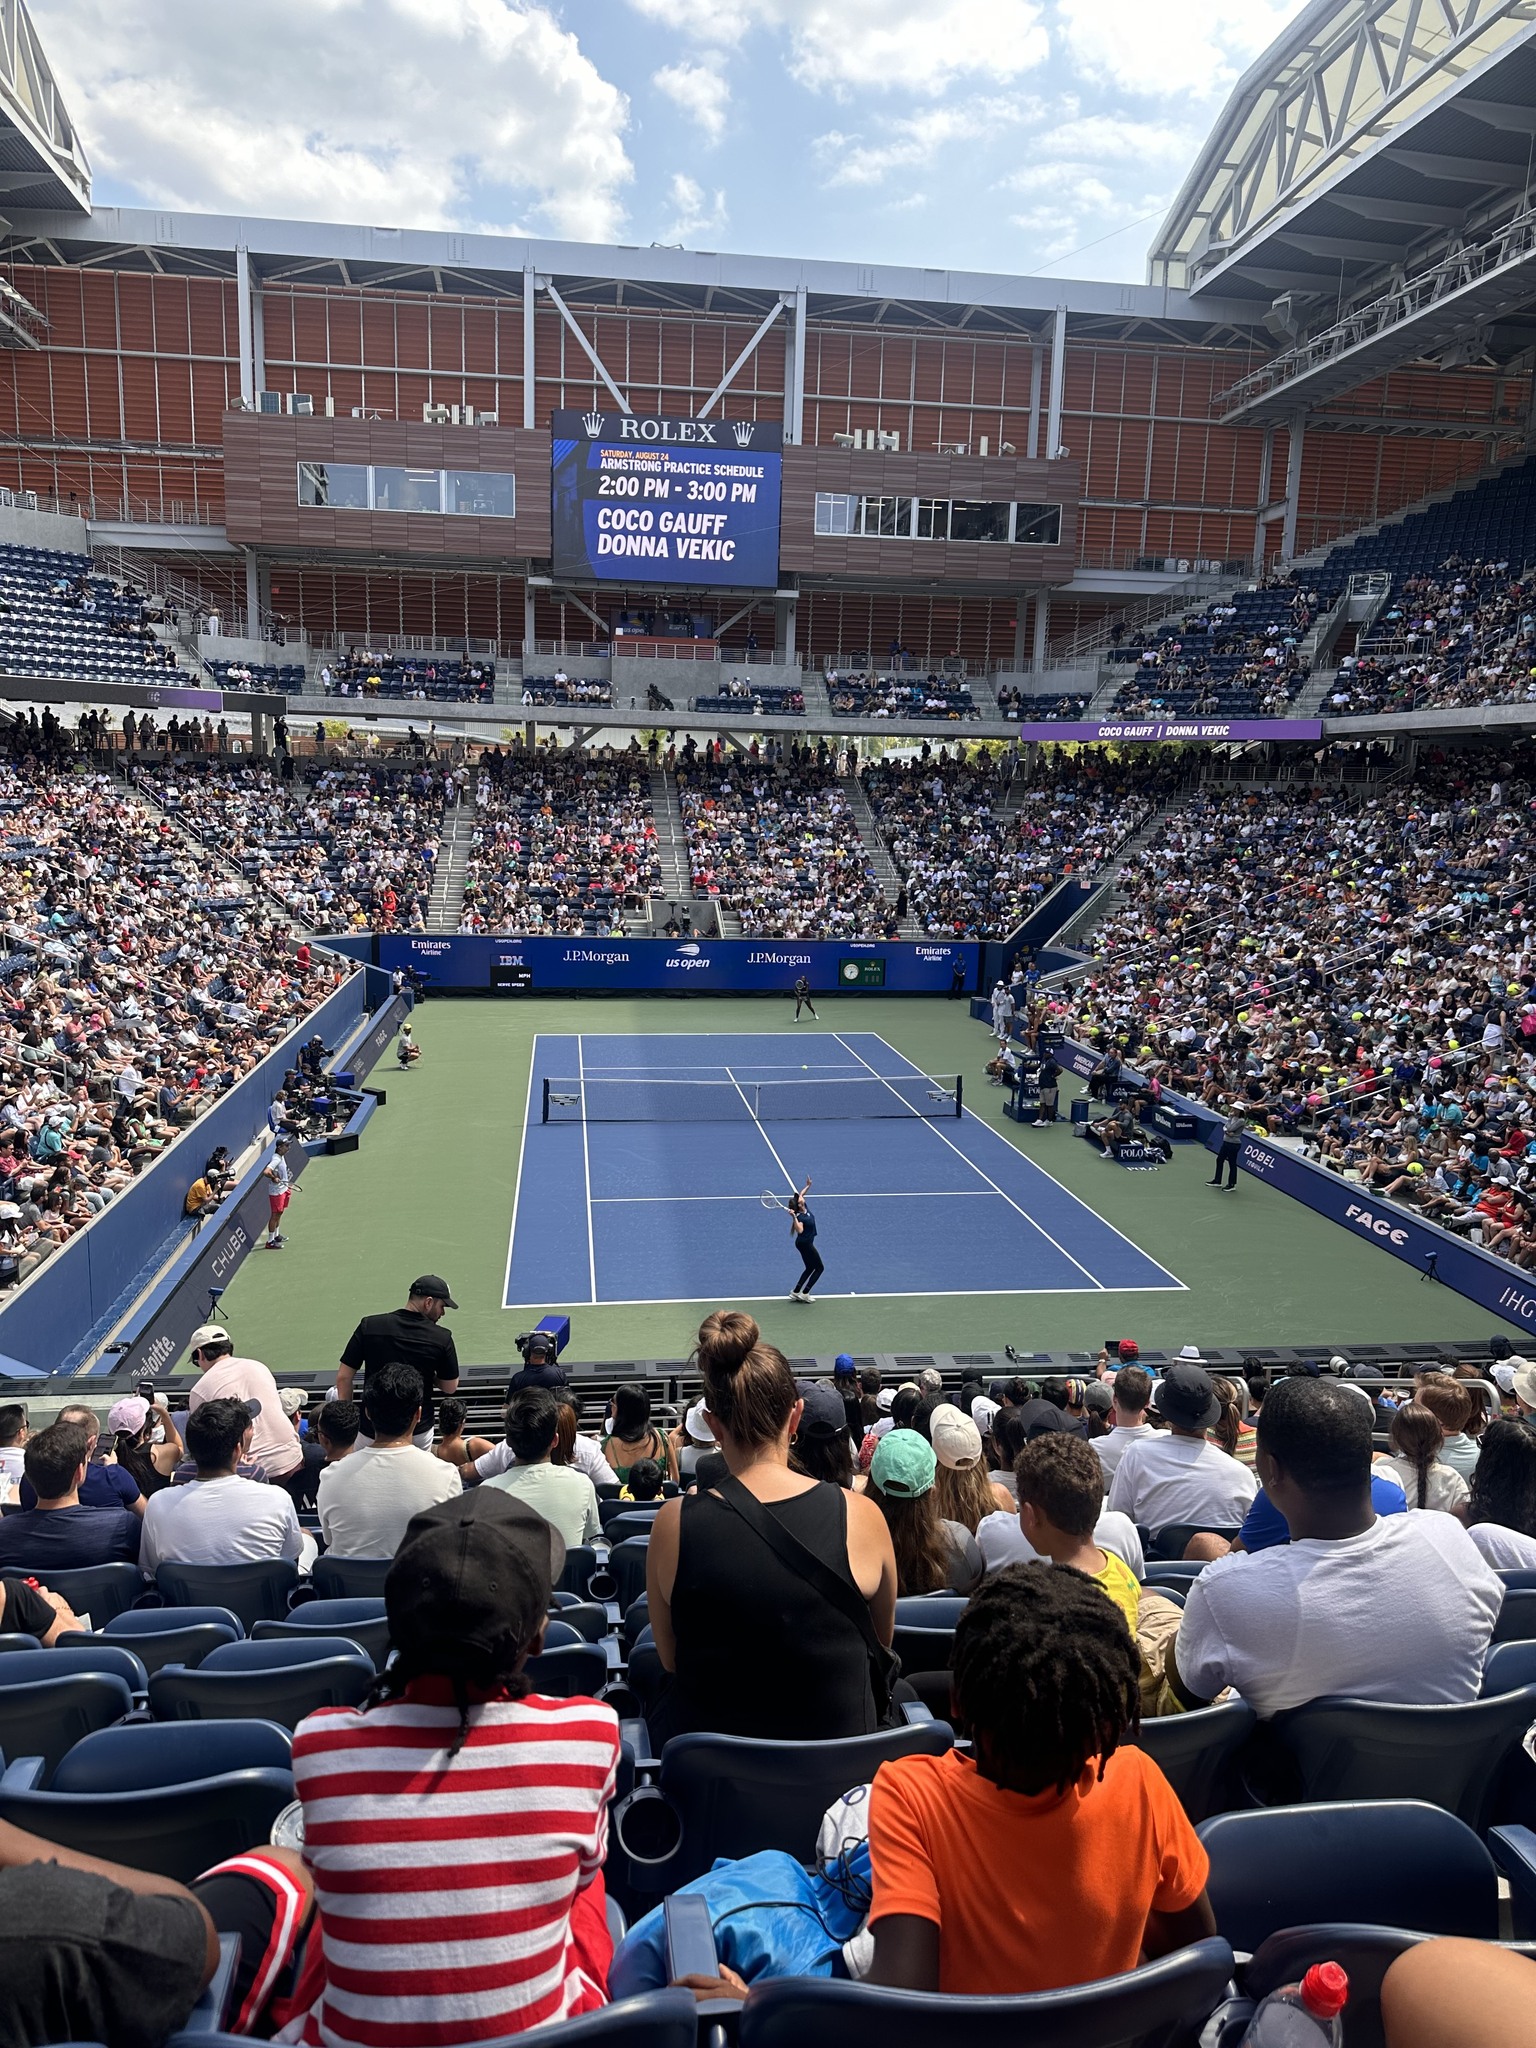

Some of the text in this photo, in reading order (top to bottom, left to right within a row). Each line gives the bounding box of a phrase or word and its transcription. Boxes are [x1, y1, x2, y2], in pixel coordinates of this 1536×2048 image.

[620, 418, 717, 443] ROLEX
[600, 449, 669, 461] SATURDAY, AUGUST 24
[600, 458, 764, 478] ARMSTRONG PRACTICE SCHEDULE
[598, 475, 640, 496] 2:00
[643, 477, 670, 498] PM
[687, 480, 727, 501] 3:00
[730, 483, 757, 503] PM
[597, 507, 728, 535] COCO GAUFF
[597, 533, 736, 561] DONNA VEKIC
[1098, 726, 1122, 737] COCO
[1123, 726, 1155, 737] GAUFF
[1165, 725, 1198, 736] DONNA
[1201, 725, 1230, 736] VEKIC
[411, 940, 451, 950] Emirates
[915, 946, 951, 955] Emirates
[499, 955, 524, 966] IBM
[563, 950, 630, 964] J.P.Morgan
[665, 958, 710, 970] us open
[747, 952, 811, 967] J.P.Morgan
[1072, 1061, 1091, 1076] EXPRESS
[1074, 1053, 1095, 1069] AMERICAN
[1155, 1112, 1171, 1128] Wilson
[1120, 1148, 1144, 1158] POLO
[1244, 1144, 1274, 1169] DOBEL
[211, 1226, 247, 1278] CHUBB
